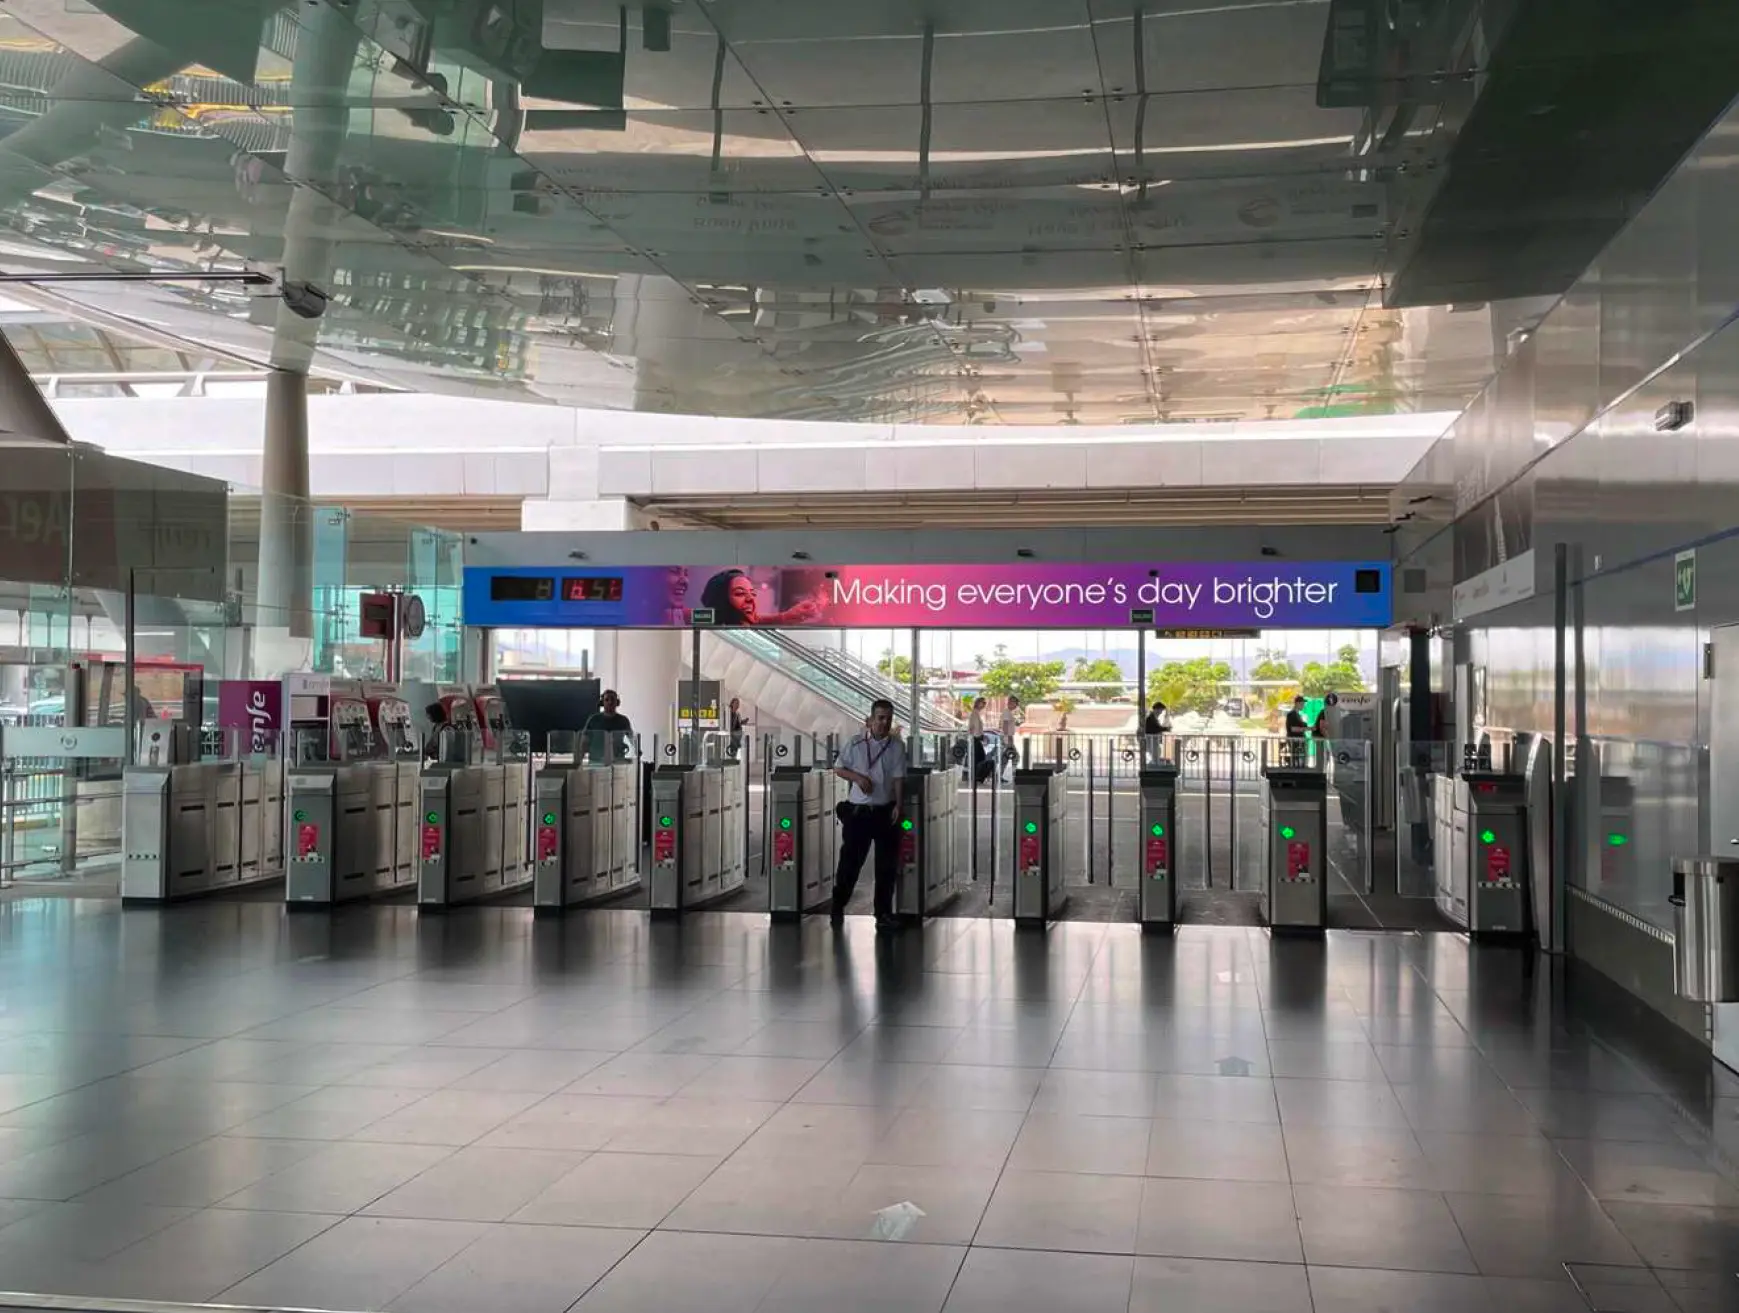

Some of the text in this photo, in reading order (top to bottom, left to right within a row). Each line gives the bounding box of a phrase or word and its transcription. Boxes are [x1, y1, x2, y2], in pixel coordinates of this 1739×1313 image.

[833, 576, 1338, 619] Making everyone's day brighter
[245, 690, 272, 753] enfe
